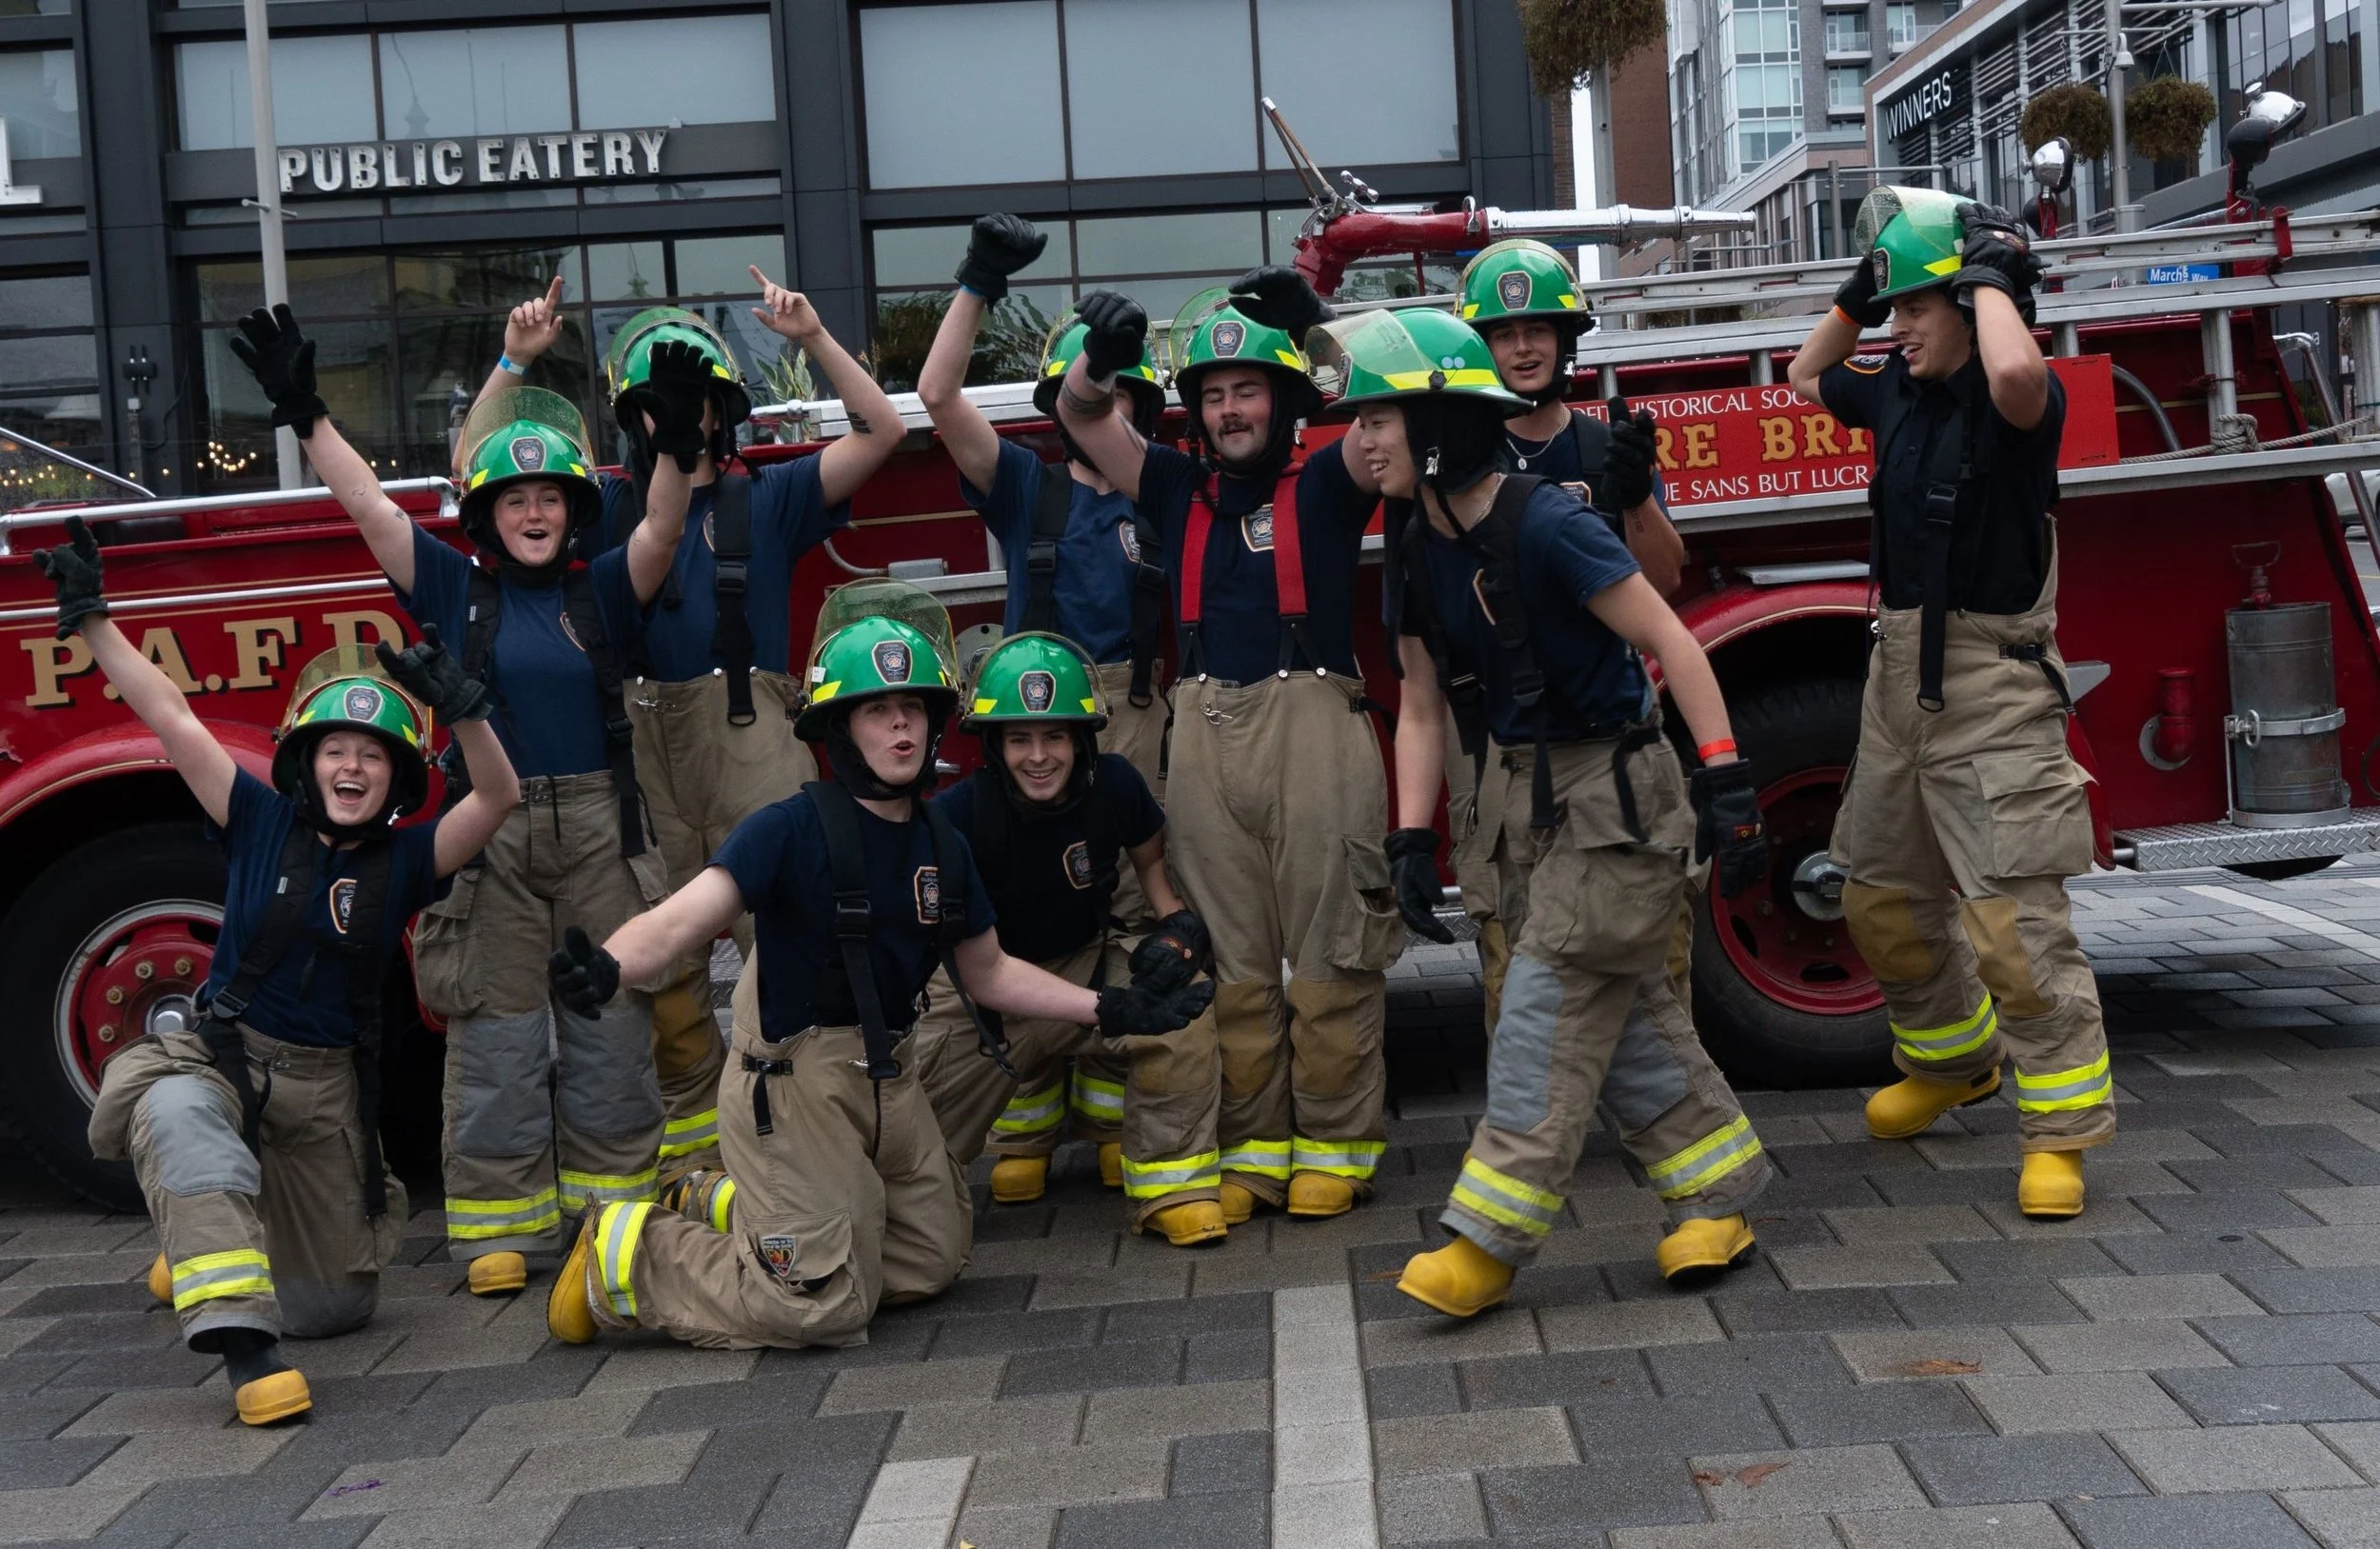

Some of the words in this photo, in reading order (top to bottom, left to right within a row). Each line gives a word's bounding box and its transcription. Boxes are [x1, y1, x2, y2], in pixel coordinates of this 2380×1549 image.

[1885, 70, 1952, 141] WINNERS
[277, 140, 465, 193] PUBLIC
[477, 129, 667, 184] EATERY
[1629, 392, 1753, 420] STORICAL
[1760, 388, 1814, 409] SOC
[1690, 475, 1750, 500] SANS
[1757, 470, 1802, 493] BUT
